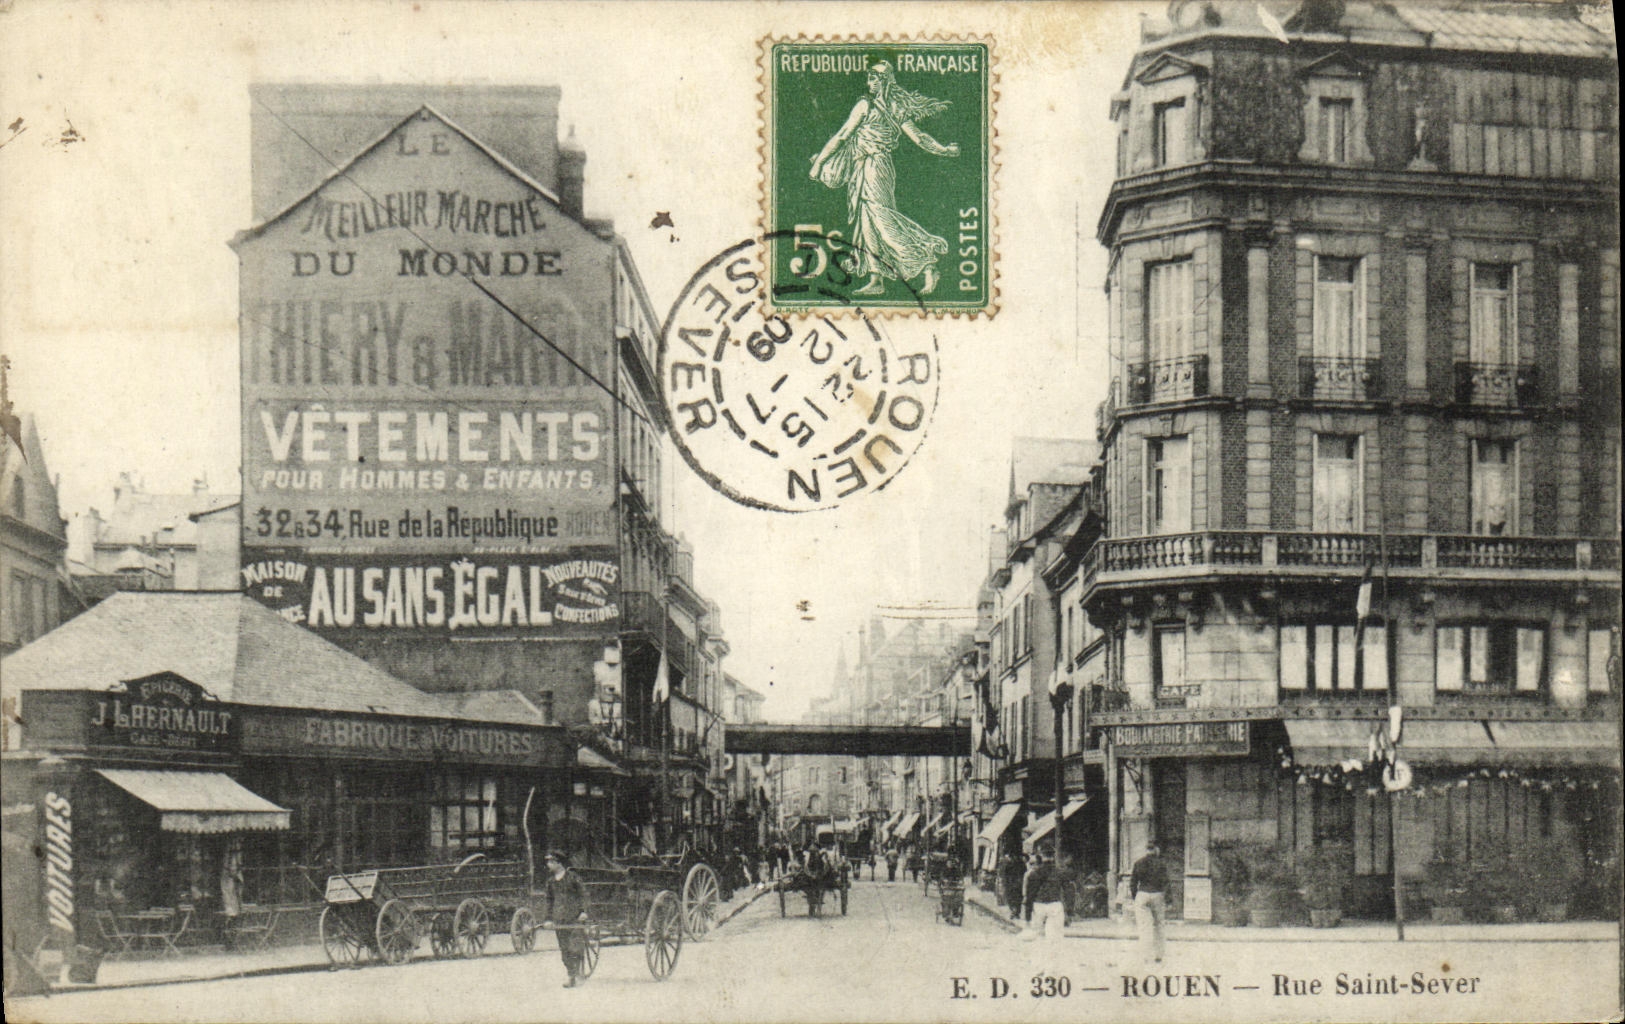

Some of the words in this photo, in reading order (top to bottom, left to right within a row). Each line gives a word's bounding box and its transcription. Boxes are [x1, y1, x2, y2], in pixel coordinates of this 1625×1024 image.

[897, 54, 978, 75] FRANÇAISE
[396, 133, 450, 157] LE
[301, 190, 429, 242] MEILLEUR
[435, 189, 547, 238] MARCHÉ
[292, 250, 356, 277] DU
[398, 248, 562, 277] MONDE
[960, 206, 977, 291] POSTES
[671, 258, 759, 434] SEVER
[260, 403, 600, 462] VÊTEMENTS
[788, 352, 931, 502] ROUEN
[261, 469, 324, 490] POUR
[340, 467, 446, 490] HOMMES
[455, 474, 471, 491] &
[484, 467, 594, 490] ENFANTS
[349, 509, 390, 539] Rue
[448, 506, 559, 544] République
[241, 560, 308, 588] MAISON
[263, 586, 284, 598] DE
[307, 567, 356, 627] AU
[363, 567, 446, 627] SANS
[305, 717, 418, 749] FABRIQUE
[431, 726, 533, 754] VOITURES
[46, 791, 74, 932] VOITURES
